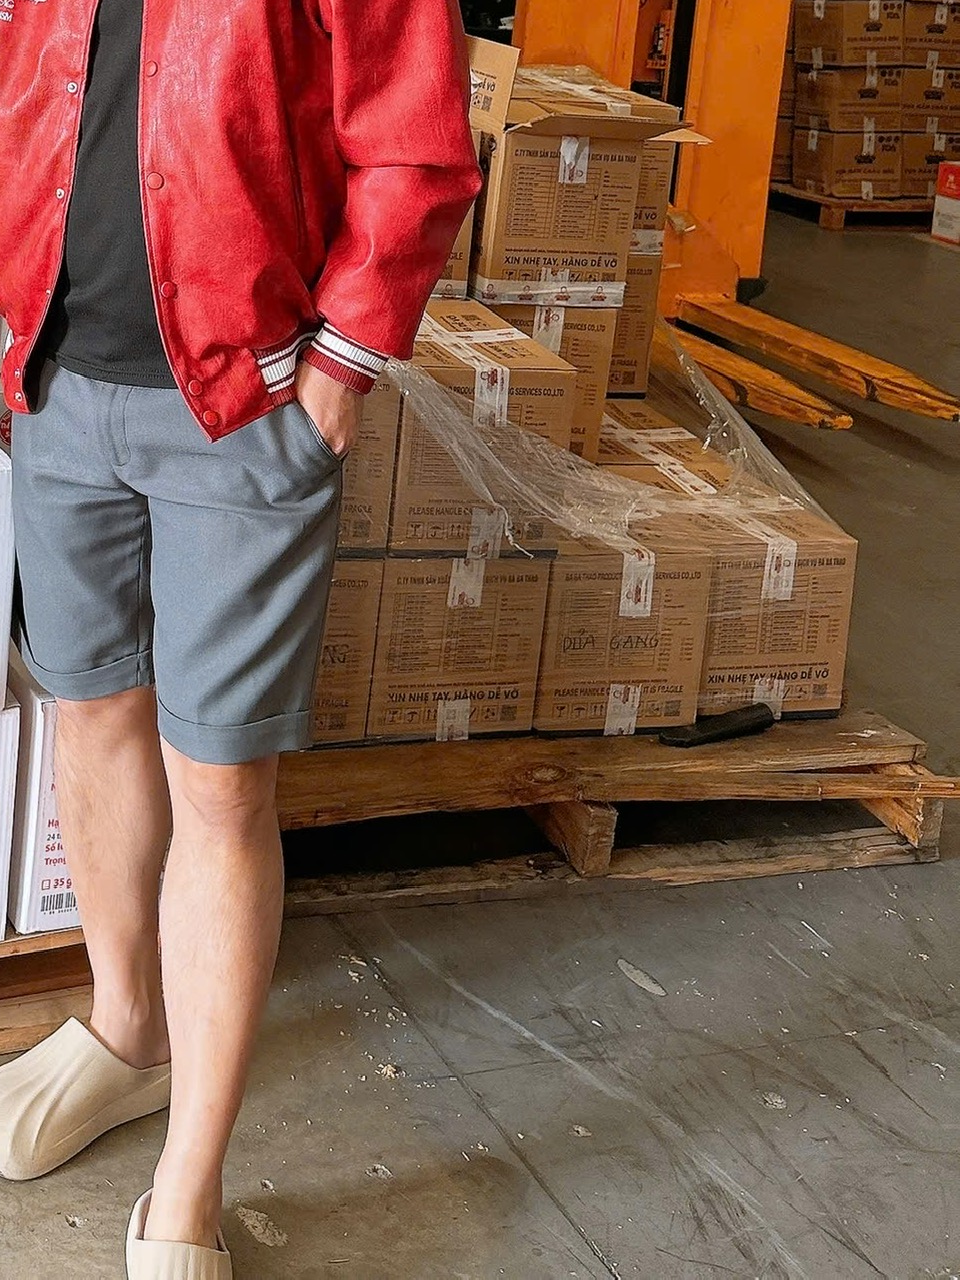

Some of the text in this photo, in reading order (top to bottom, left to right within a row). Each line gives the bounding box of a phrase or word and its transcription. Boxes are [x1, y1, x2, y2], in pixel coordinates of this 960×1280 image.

[504, 256, 520, 264] XIN
[523, 256, 540, 267] NHẸ
[543, 257, 559, 266] TAY,
[561, 256, 588, 266] HÀNG
[388, 693, 405, 702] XIN
[409, 692, 429, 704] NHẸ
[454, 689, 485, 700] HÀNG
